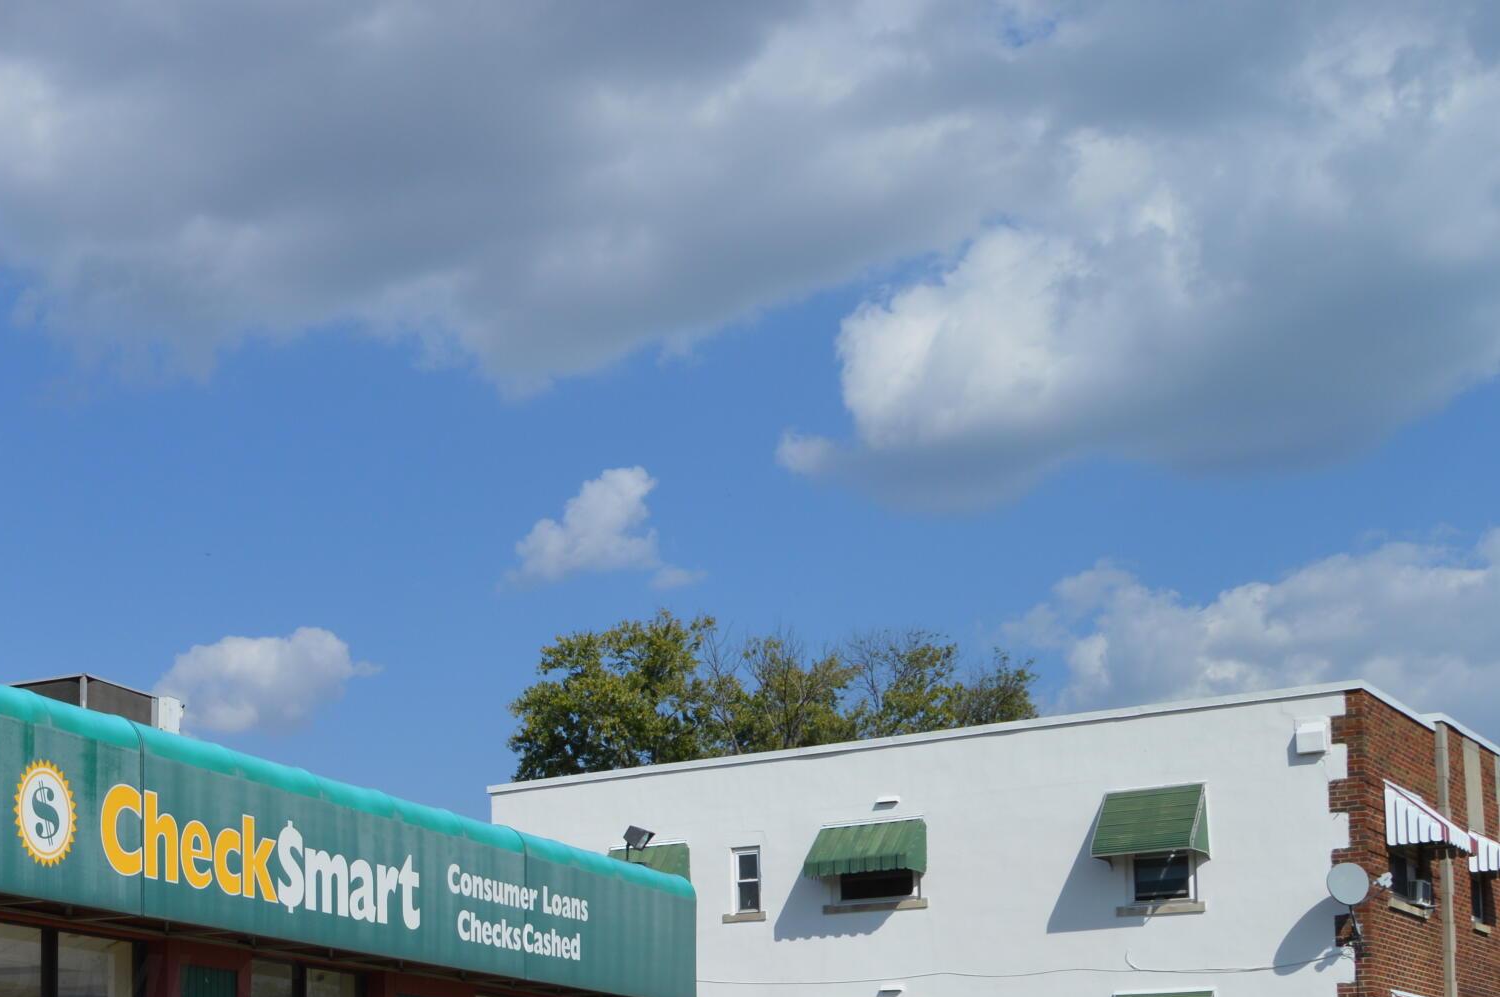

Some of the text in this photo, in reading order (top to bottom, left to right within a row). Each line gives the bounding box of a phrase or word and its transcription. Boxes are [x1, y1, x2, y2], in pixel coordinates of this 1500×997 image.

[447, 863, 589, 922] Consumer Loans
[457, 909, 581, 961] Checks Cashed
